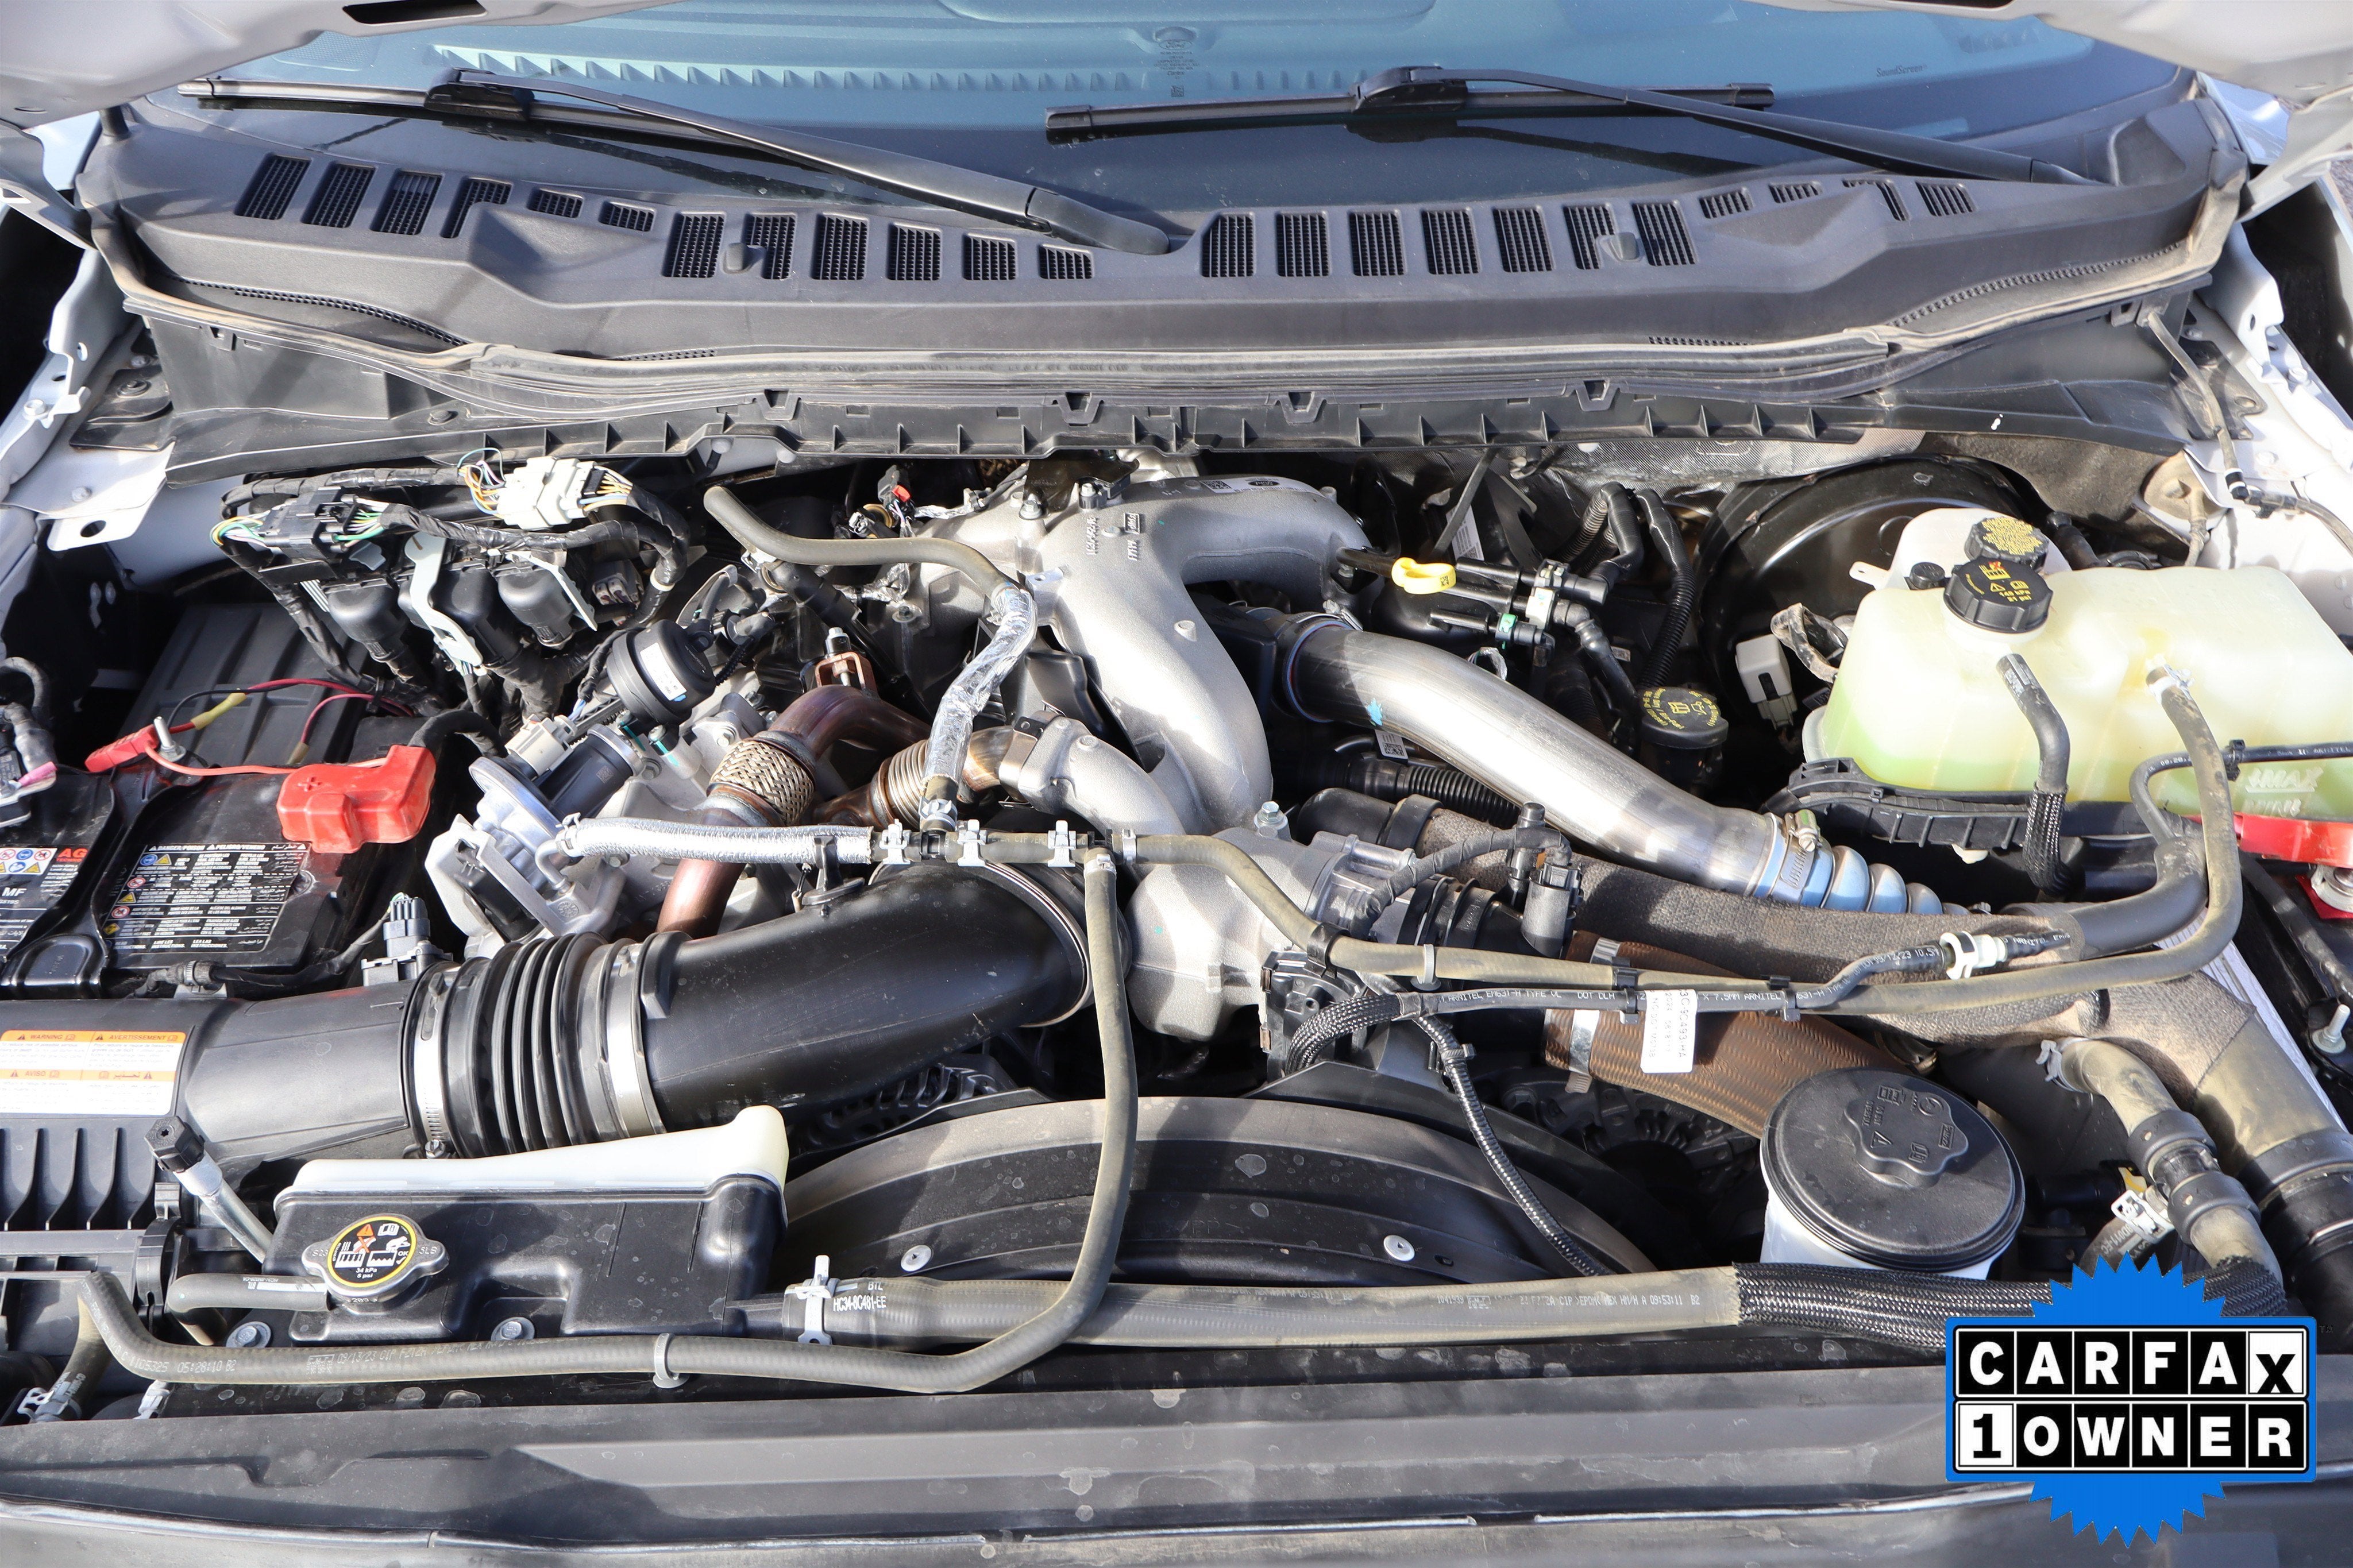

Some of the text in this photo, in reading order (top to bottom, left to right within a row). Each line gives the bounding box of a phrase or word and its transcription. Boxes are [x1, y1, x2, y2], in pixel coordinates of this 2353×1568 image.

[57, 848, 88, 858] AG
[2, 887, 27, 897] MF
[1650, 1295, 1683, 1306] 09:53:11
[1690, 1294, 1700, 1306] B2
[177, 1360, 222, 1373] 05:28:10
